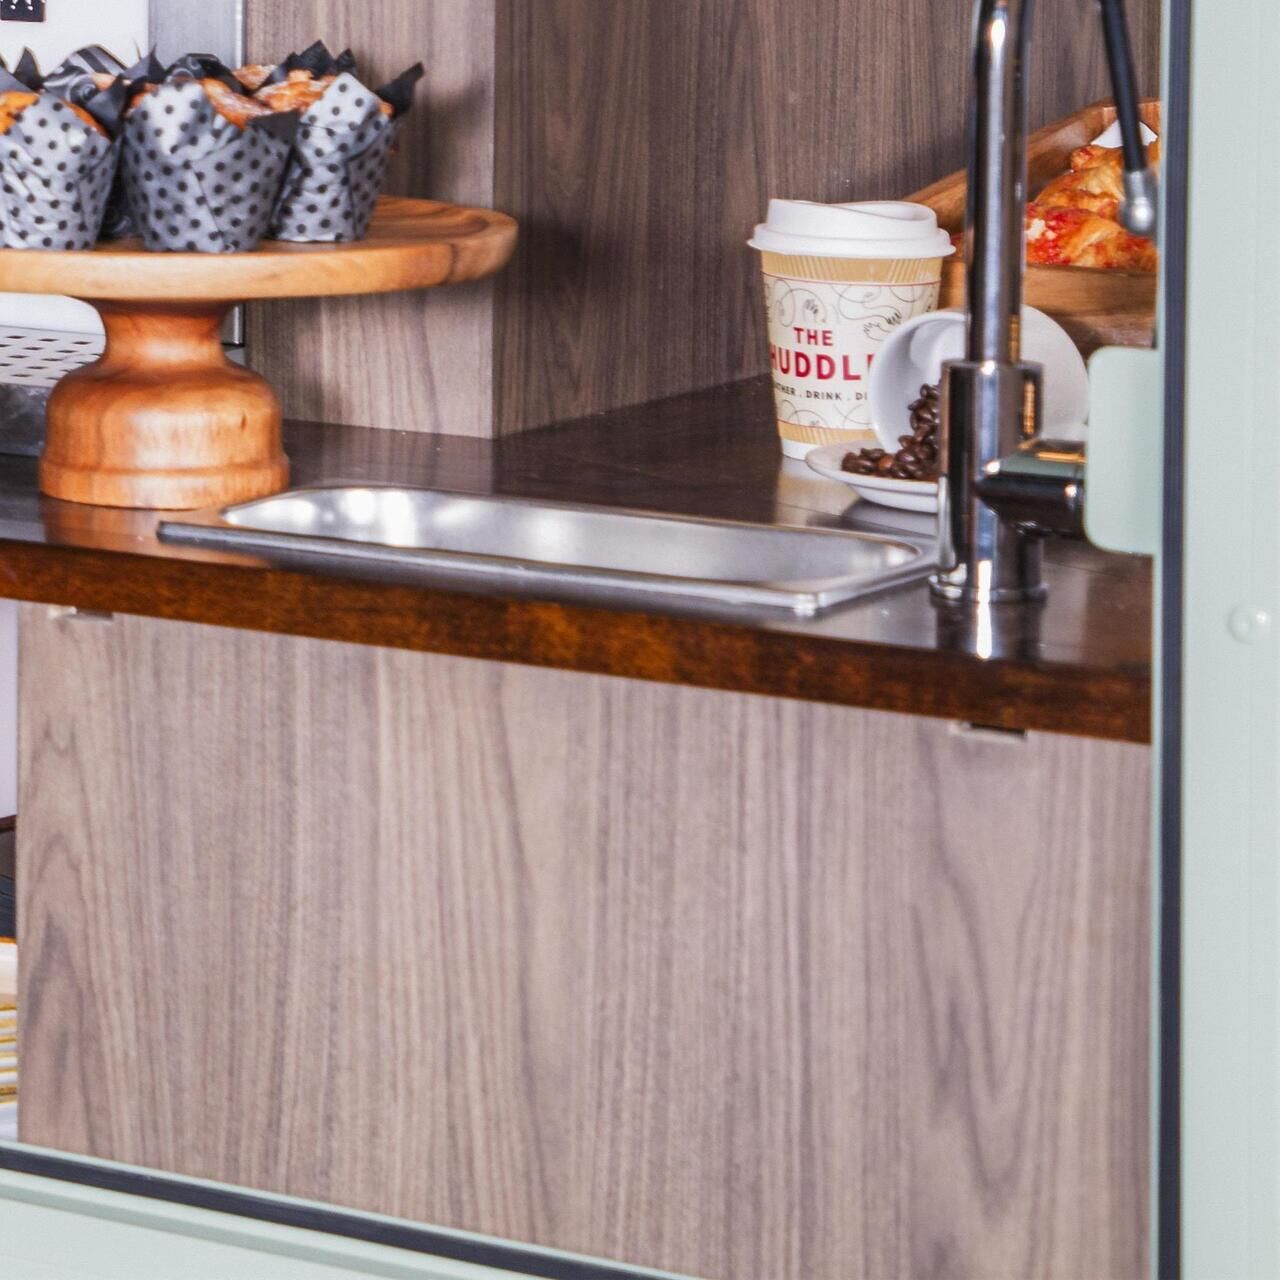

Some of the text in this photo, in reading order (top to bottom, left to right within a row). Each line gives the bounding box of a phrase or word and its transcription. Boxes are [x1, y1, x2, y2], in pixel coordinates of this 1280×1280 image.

[793, 326, 834, 347] THE
[806, 390, 842, 401] DRINK
[855, 392, 868, 401] DI
